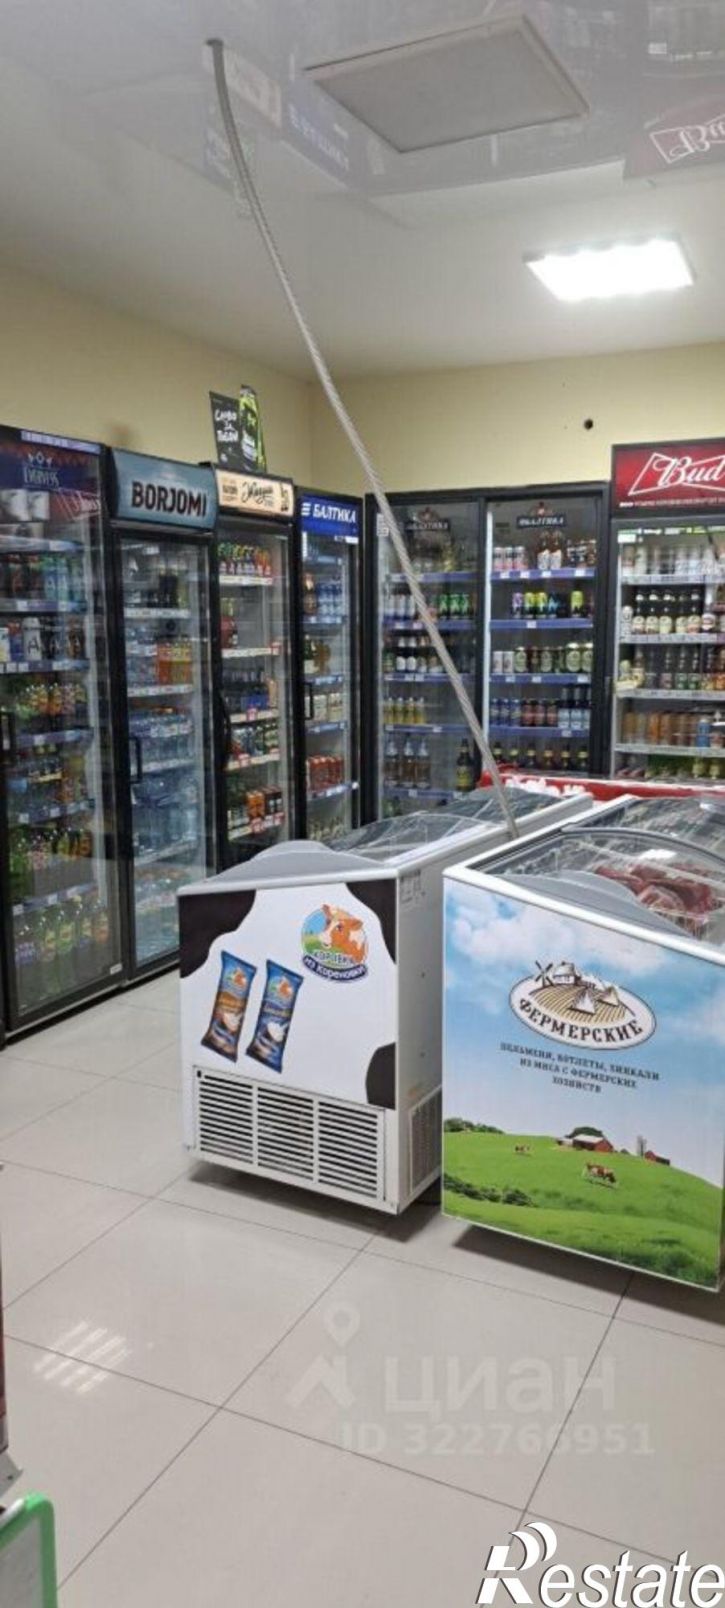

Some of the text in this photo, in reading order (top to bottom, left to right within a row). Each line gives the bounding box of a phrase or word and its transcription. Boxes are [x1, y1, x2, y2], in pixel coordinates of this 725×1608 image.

[653, 456, 725, 488] Bud
[131, 481, 207, 517] BORJOMI
[313, 503, 357, 524] БАЛТИКА
[519, 997, 643, 1043] ФЕРМЕРСКИЕ
[520, 1058, 637, 1089] ИЗ МЯСА С ФЕРМЕРСКИХ
[552, 1076, 602, 1094] ХОЗЯЙСТВ
[609, 1064, 660, 1081] ХИНКАЛИ
